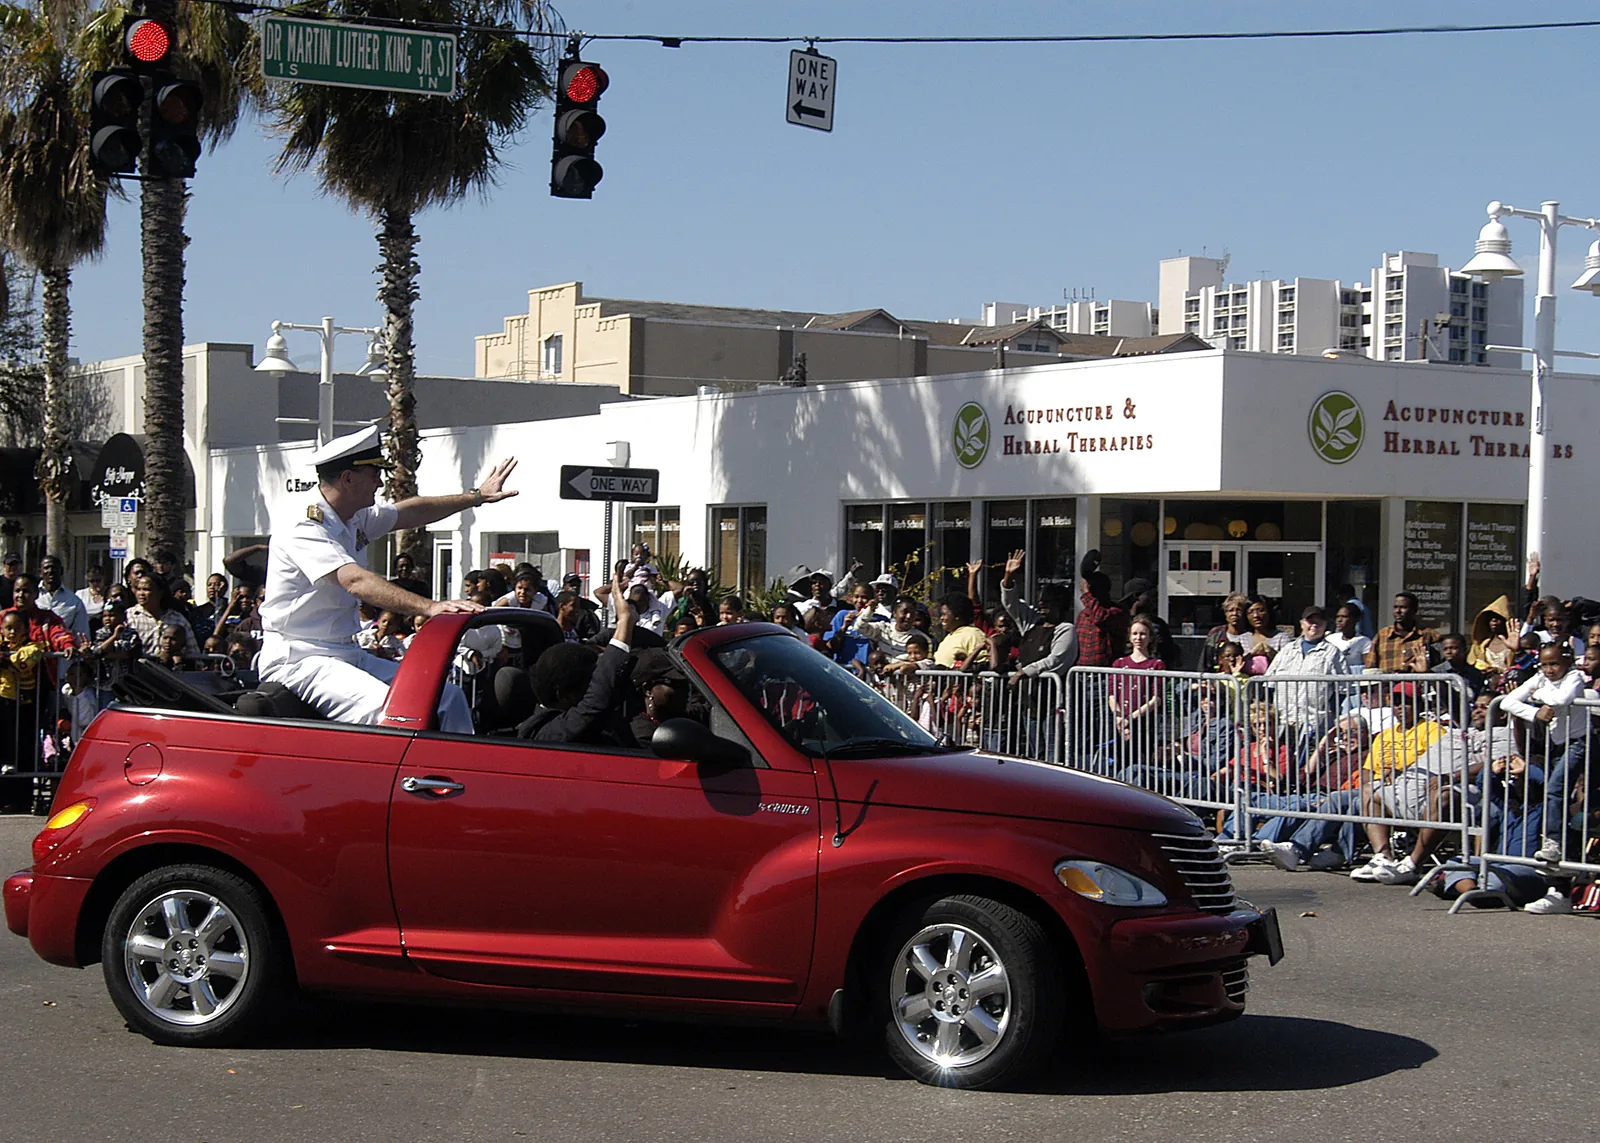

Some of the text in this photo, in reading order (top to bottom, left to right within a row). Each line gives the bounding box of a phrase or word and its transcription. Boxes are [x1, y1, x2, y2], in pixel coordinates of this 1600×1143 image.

[266, 22, 452, 78] DR MARTIN LUTHER KING JR ST
[289, 64, 299, 77] S
[428, 77, 438, 89] N
[797, 57, 829, 81] ONE
[795, 77, 829, 101] WAY
[1003, 397, 1136, 425] ACUPUNCTURE &
[1383, 399, 1526, 427] ACUPUNCTURE
[1003, 432, 1153, 456] HERBAL THERAPIES
[1383, 431, 1574, 459] HERBAL THERAES
[590, 477, 648, 493] ONE WAY
[767, 803, 810, 815] CRUISER
